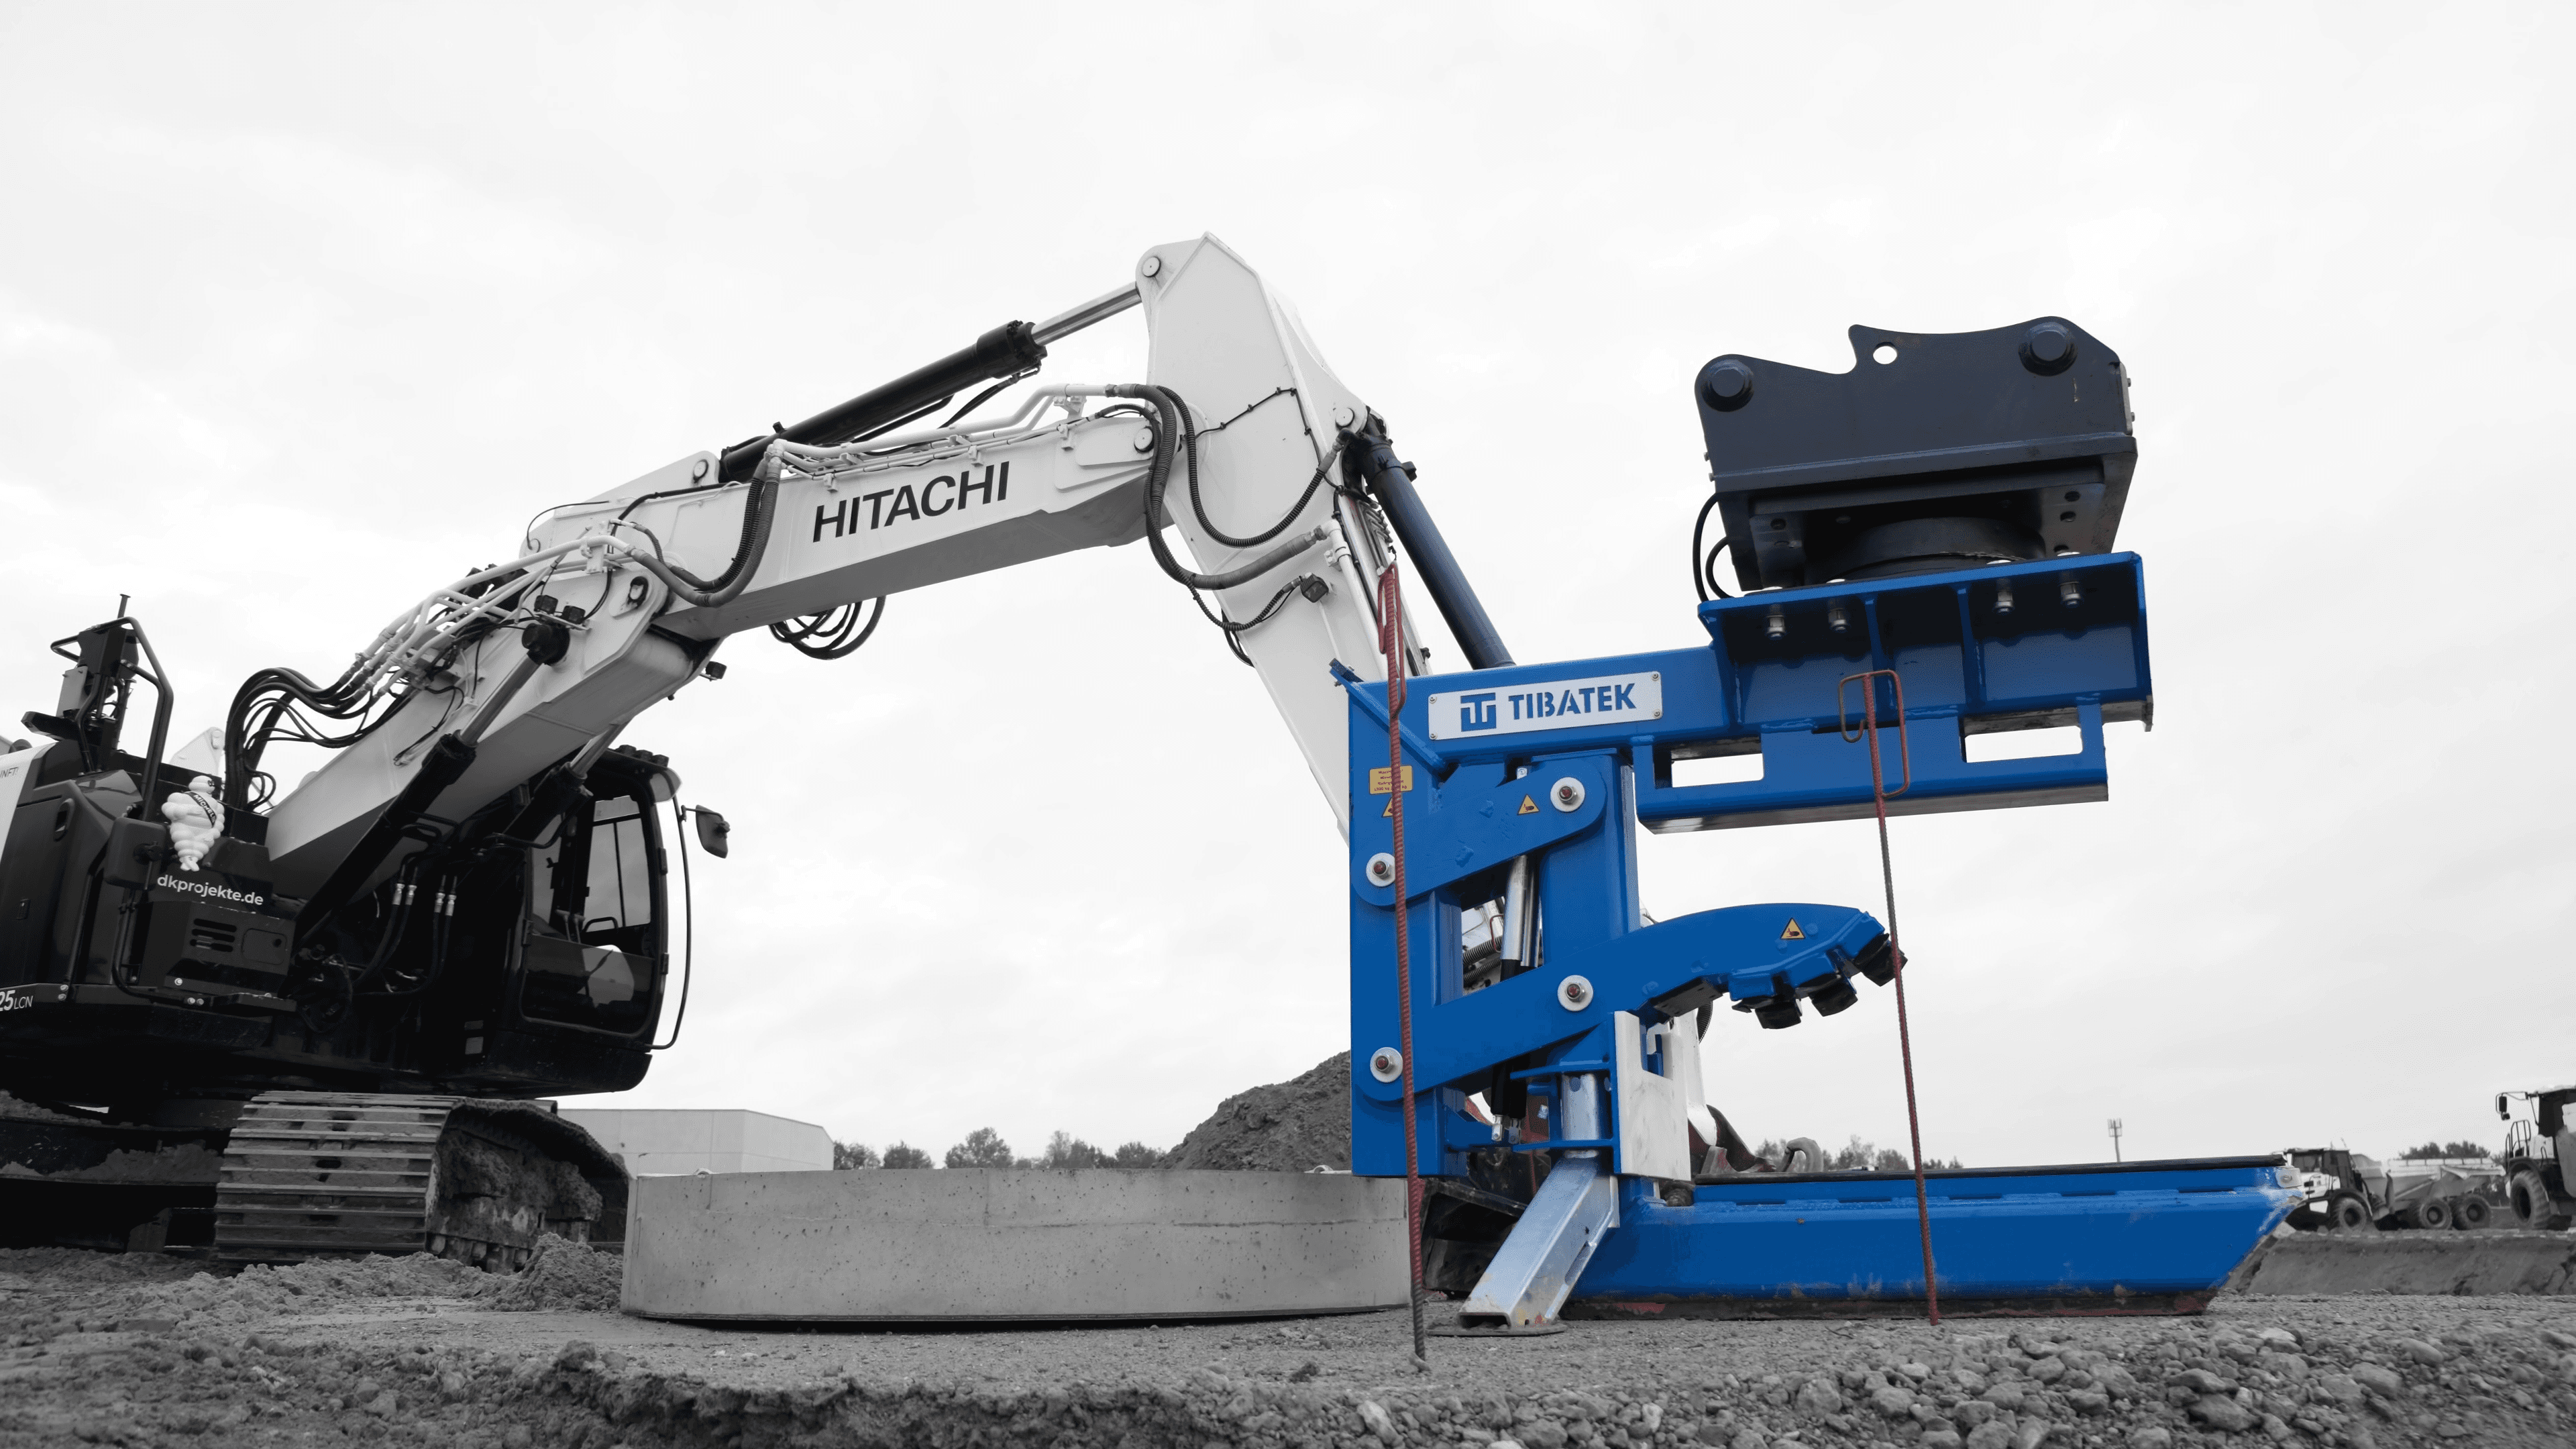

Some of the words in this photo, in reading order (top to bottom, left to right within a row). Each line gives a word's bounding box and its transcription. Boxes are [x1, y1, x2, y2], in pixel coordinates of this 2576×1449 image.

[813, 461, 1010, 543] HITACHI
[1508, 683, 1637, 720] TIBATEK
[157, 874, 264, 906] dkprojekte.de
